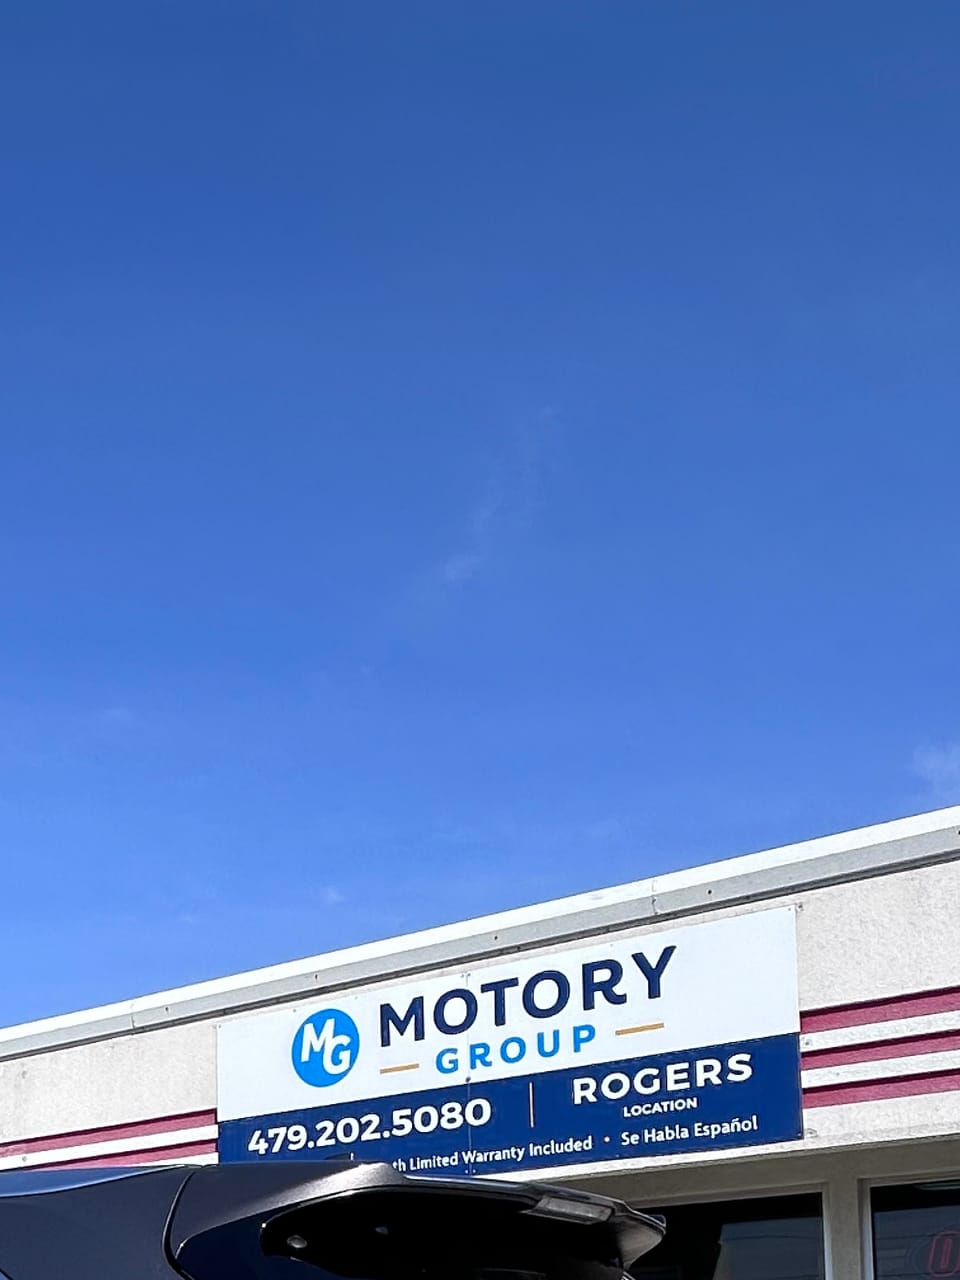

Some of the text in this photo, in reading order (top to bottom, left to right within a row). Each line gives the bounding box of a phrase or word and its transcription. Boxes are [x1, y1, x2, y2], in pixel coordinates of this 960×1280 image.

[379, 945, 677, 1048] MOTORY
[300, 1017, 352, 1075] MG
[435, 1024, 596, 1074] GROUP
[573, 1053, 753, 1104] ROGERS
[247, 1098, 492, 1155] 479.202.5080
[623, 1097, 698, 1118] LOCATION
[409, 1151, 459, 1172] Limited
[461, 1146, 526, 1166] Warranty
[529, 1135, 593, 1157] Included
[621, 1131, 640, 1146] Se
[644, 1124, 690, 1143] Habla
[694, 1115, 759, 1139] Español
